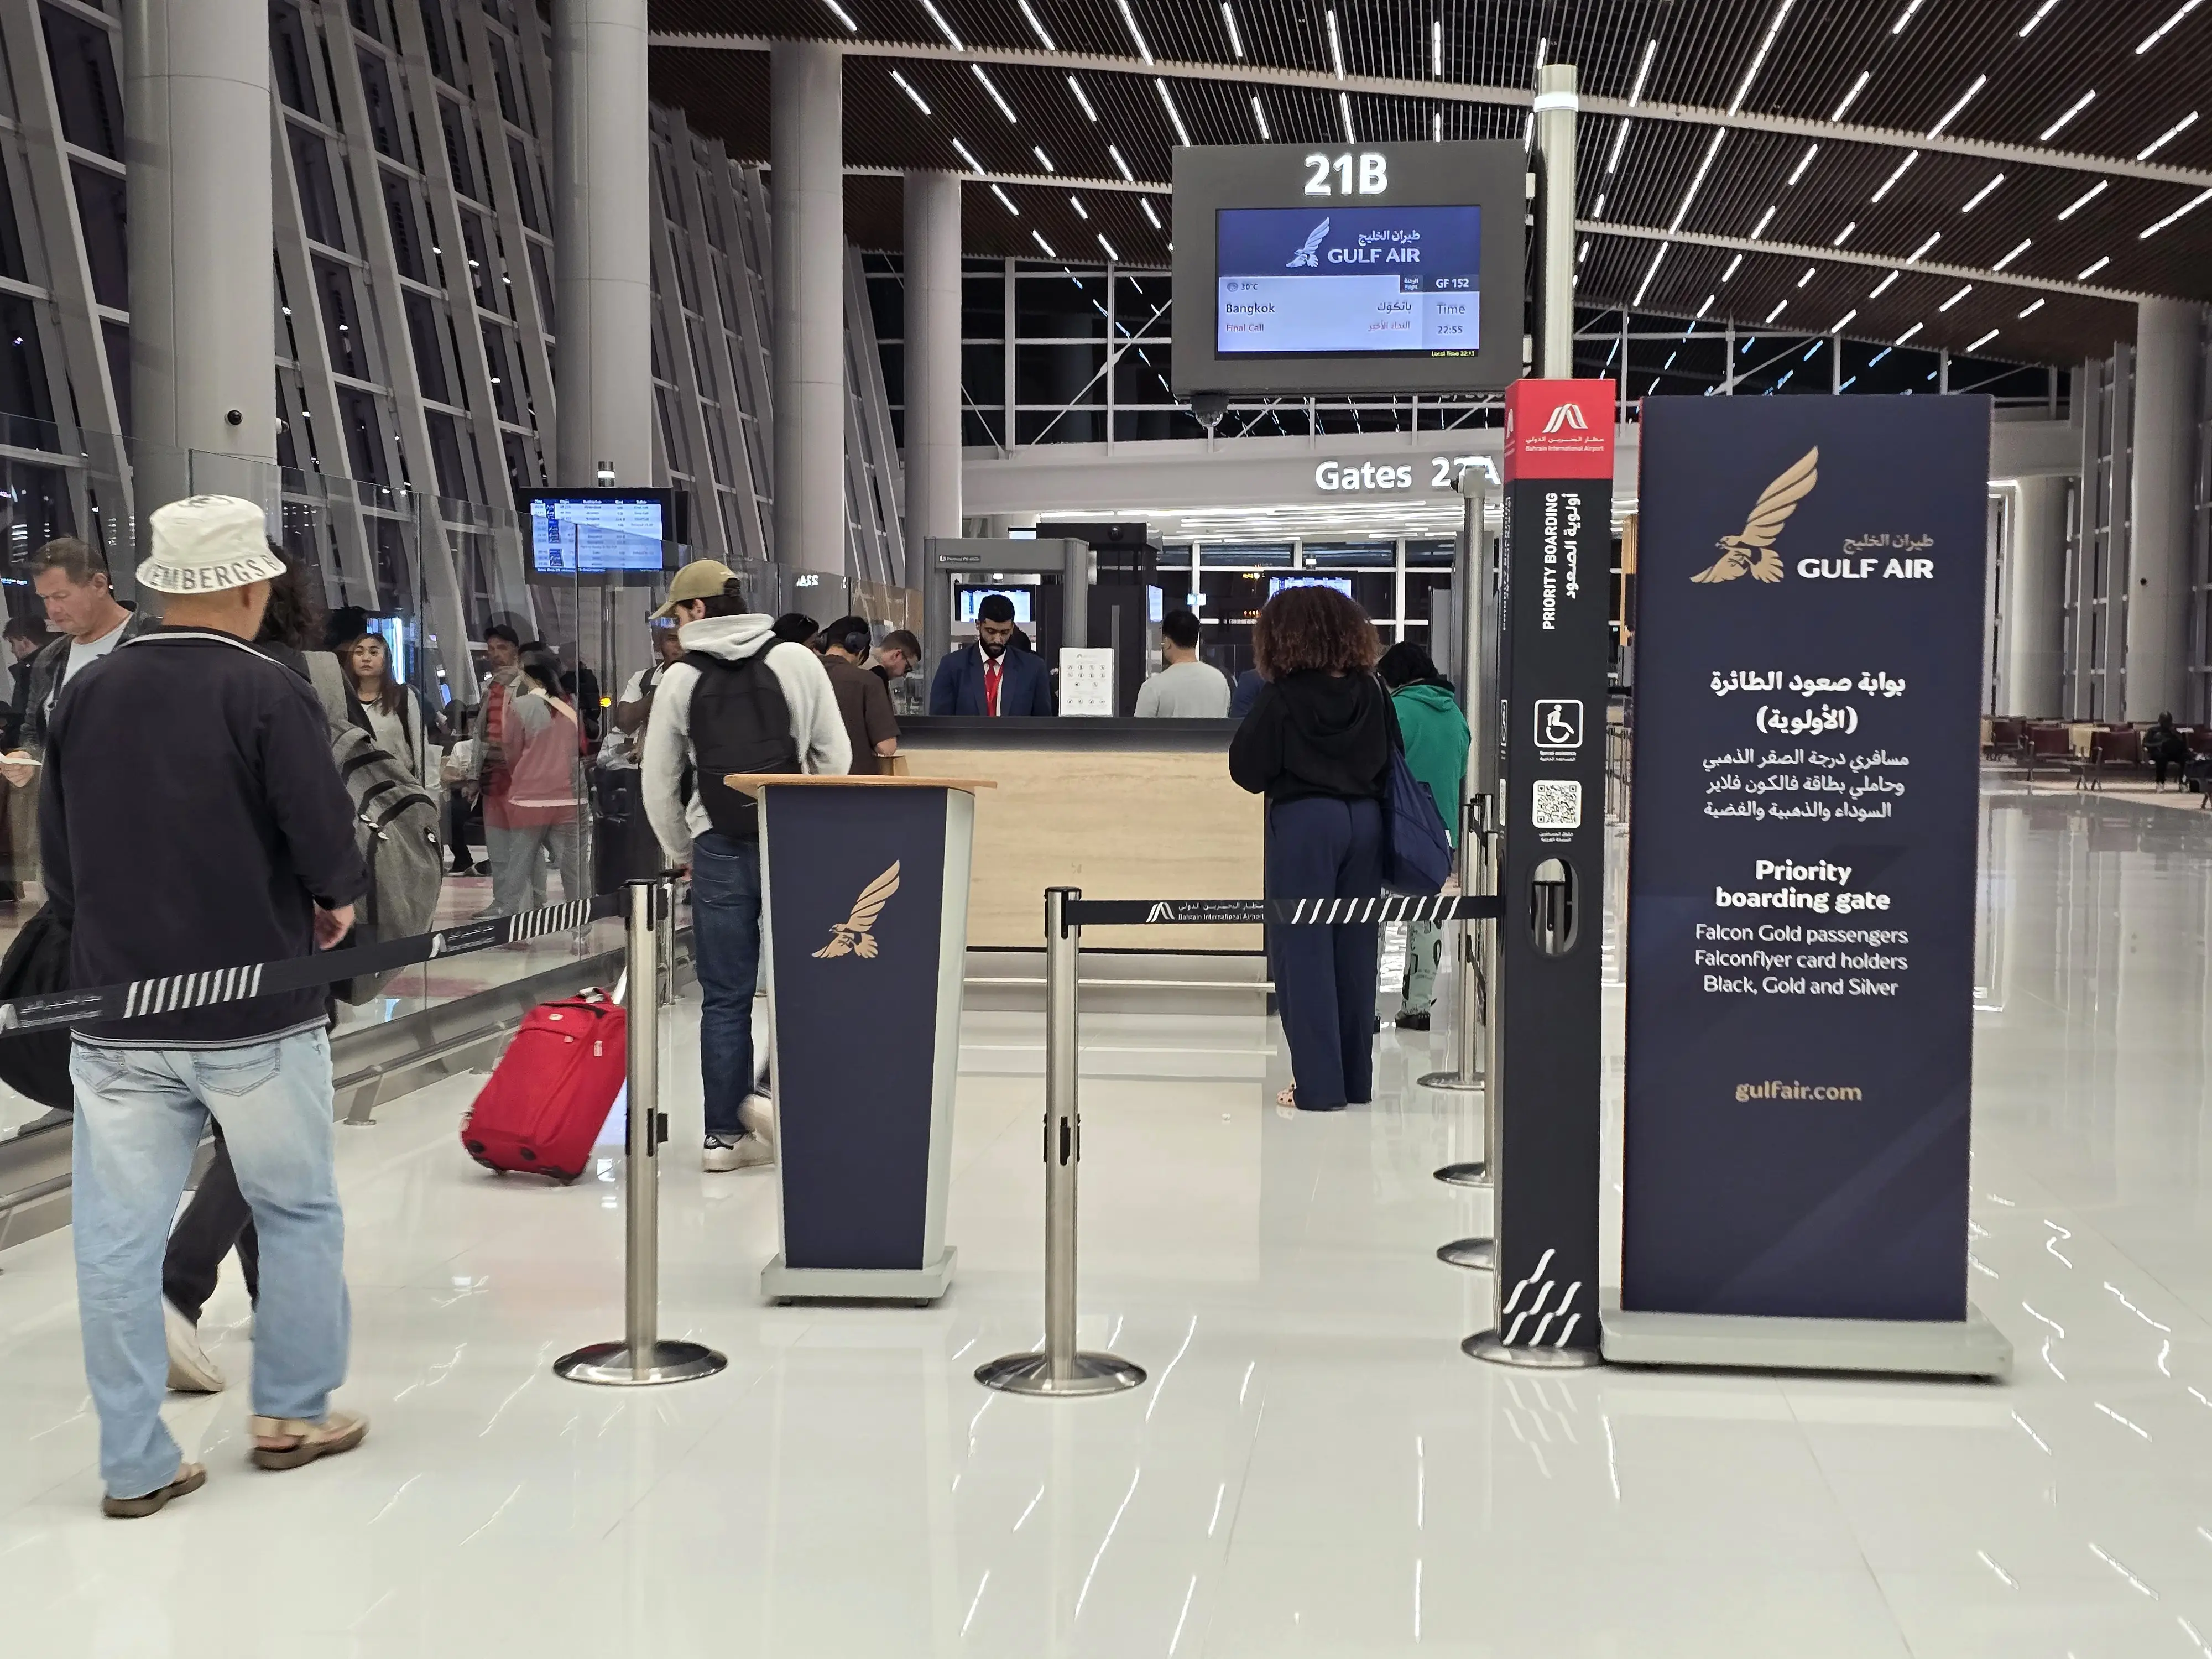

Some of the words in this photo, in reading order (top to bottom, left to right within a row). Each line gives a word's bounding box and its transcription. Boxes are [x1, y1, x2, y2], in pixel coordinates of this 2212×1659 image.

[1304, 152, 1387, 195] 21B
[1358, 230, 1390, 247] الخليج
[1391, 229, 1420, 244] طيران
[1327, 248, 1382, 263] GULF
[1385, 248, 1420, 263] AIR
[1436, 278, 1449, 288] GF
[1452, 278, 1469, 288] 152
[1226, 302, 1275, 315] Bangkok
[1436, 304, 1465, 314] Time
[1226, 324, 1246, 332] Final
[1437, 326, 1463, 334] 22:55
[1315, 461, 1412, 490] Gates
[1561, 493, 1581, 536] أولوية
[1544, 493, 1558, 564] BOARDING
[1843, 534, 1890, 555] الخليج
[1892, 534, 1934, 551] طيران
[1564, 541, 1579, 599] الصعود
[1797, 558, 1879, 578] GULF
[1882, 558, 1934, 579] AIR
[1542, 567, 1557, 630] PRIORITY
[1710, 670, 1783, 697] الطائرة
[1788, 675, 1852, 697] صعود
[1858, 671, 1906, 698] بوابة
[1756, 703, 1858, 735] (الأولوية)
[1702, 748, 1754, 773] الذهبي
[1757, 749, 1804, 769] الصقر
[1808, 750, 1846, 769] درجة
[1849, 749, 1910, 774] مسافري
[1705, 774, 1741, 794] فلاير
[1745, 775, 1799, 795] فالكون
[1803, 775, 1846, 794] بطاقة
[1849, 775, 1905, 800] وحاملي
[1703, 800, 1765, 821] والفضية
[1768, 801, 1832, 822] والذهبية
[1835, 801, 1892, 822] السوداء
[1756, 859, 1852, 886] Priority
[1715, 886, 1830, 914] boarding
[1835, 891, 1891, 914] gate
[1695, 924, 1754, 941] Falcon
[1758, 924, 1802, 942] Gold
[1806, 929, 1909, 947] passengers
[1695, 950, 1793, 971] Falconflyer
[1796, 951, 1836, 969] card
[1841, 952, 1908, 970] holders
[1704, 975, 1757, 995] Black,
[1762, 976, 1806, 994] Gold
[1809, 978, 1844, 995] and
[1848, 978, 1899, 996] Silver
[1735, 1080, 1862, 1103] gulfair.com
